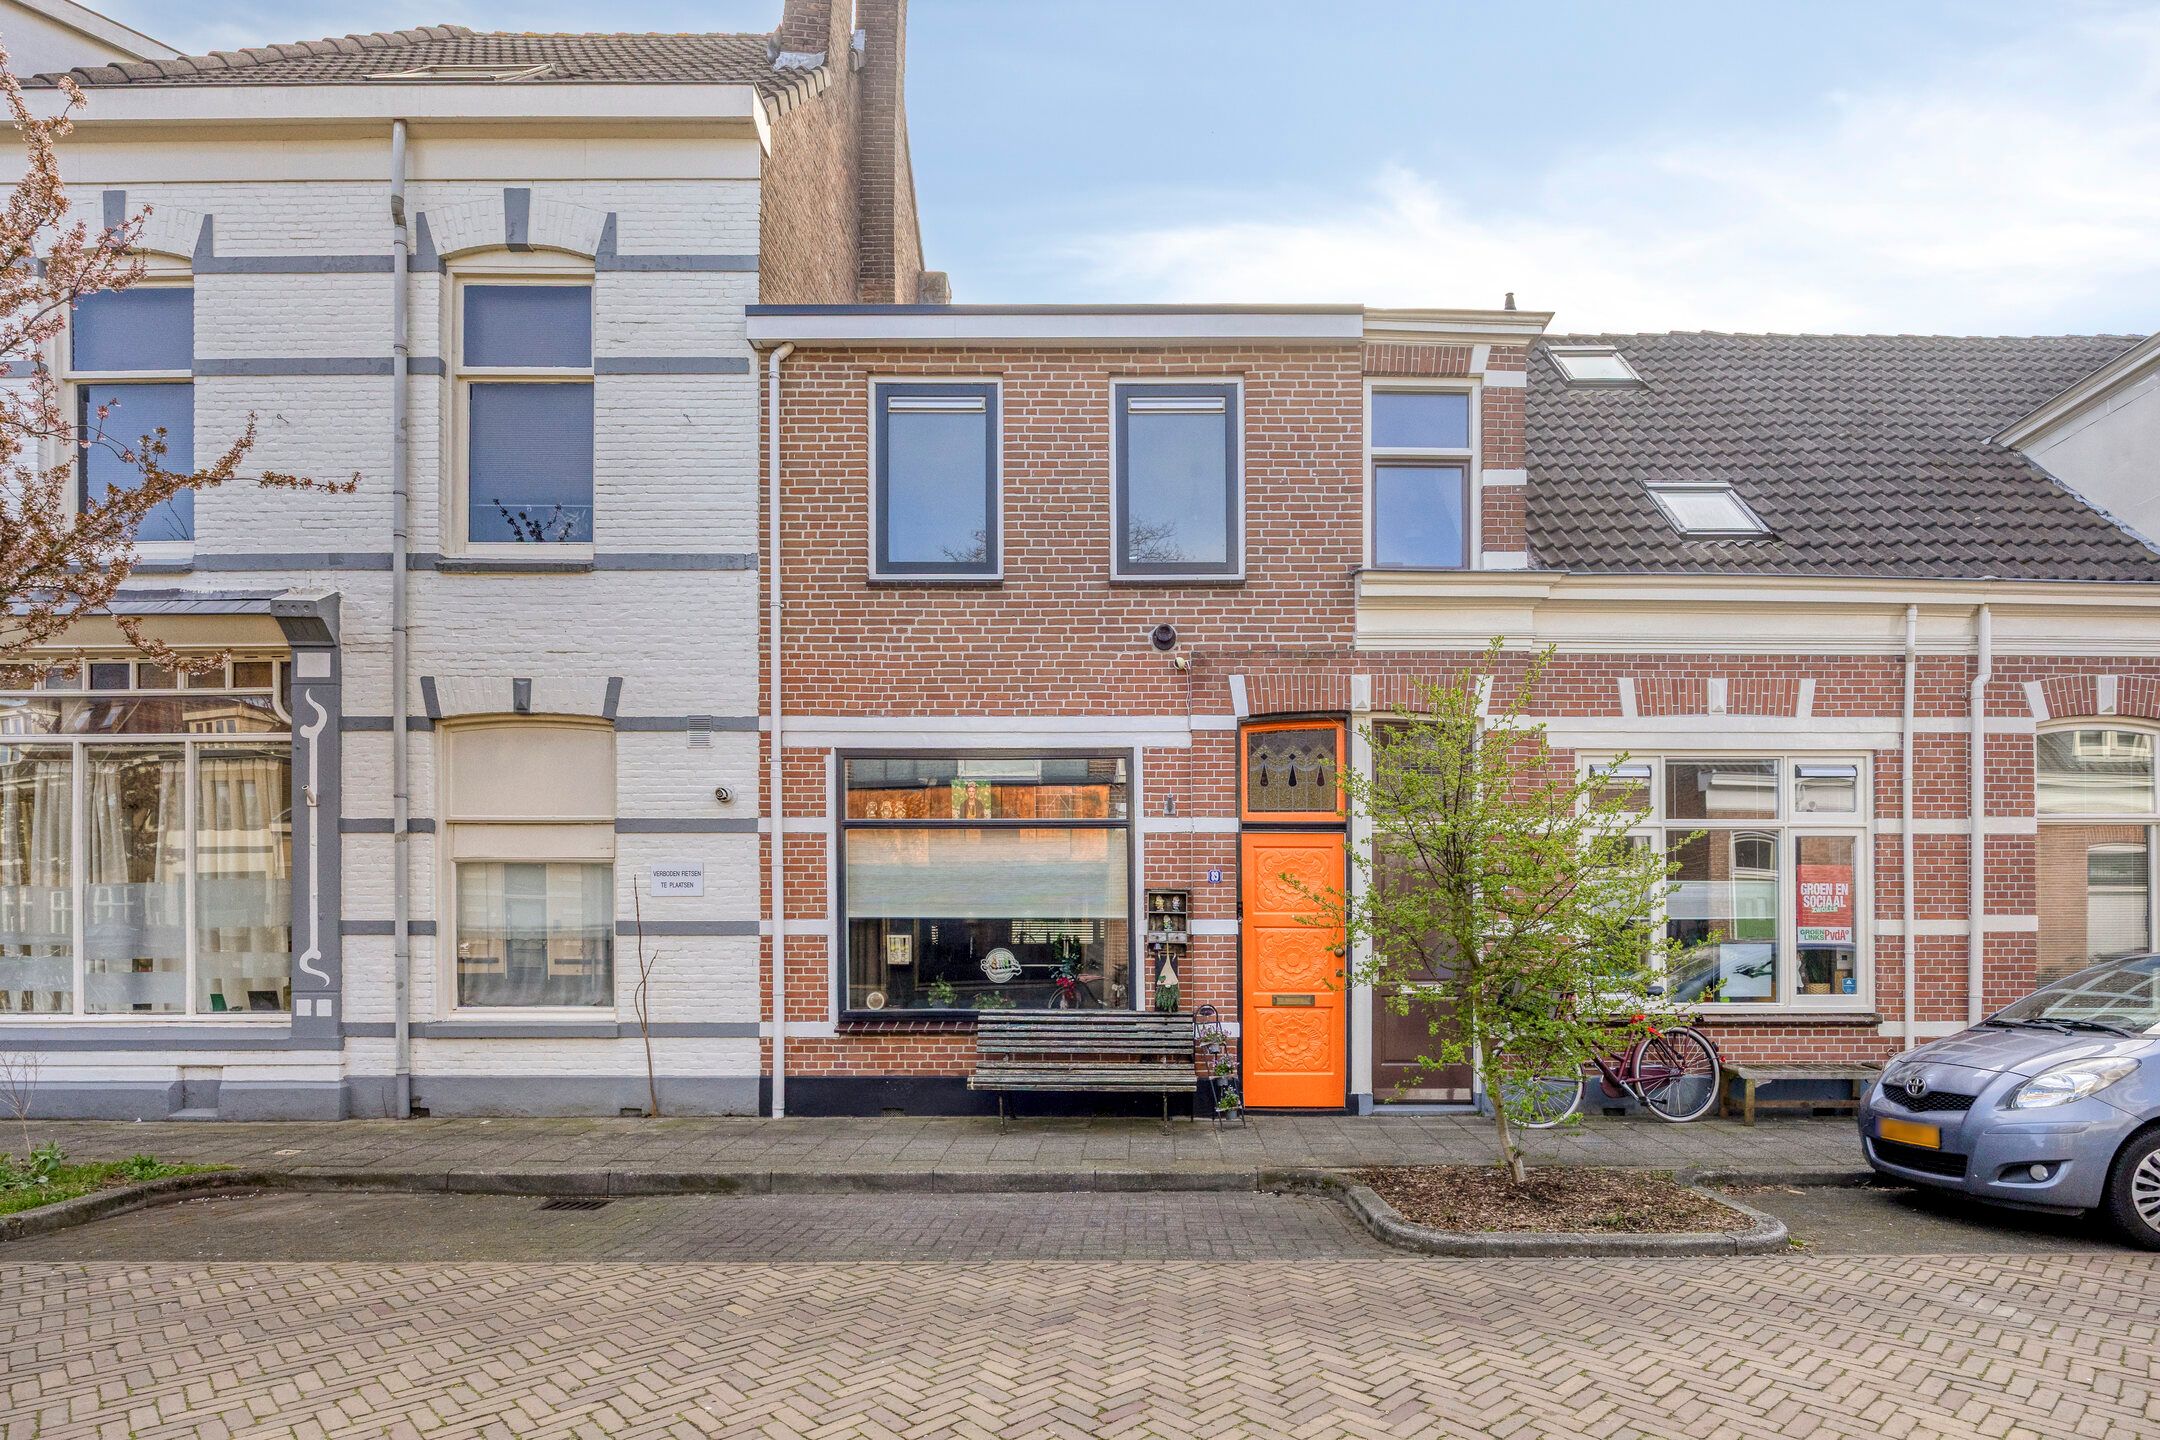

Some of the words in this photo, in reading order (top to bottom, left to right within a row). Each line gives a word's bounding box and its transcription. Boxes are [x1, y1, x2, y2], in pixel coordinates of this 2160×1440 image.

[1801, 883, 1833, 895] GROEN
[1836, 883, 1848, 895] EN
[1803, 896, 1846, 907] SOCIAAL
[1825, 930, 1846, 940] PvdA
